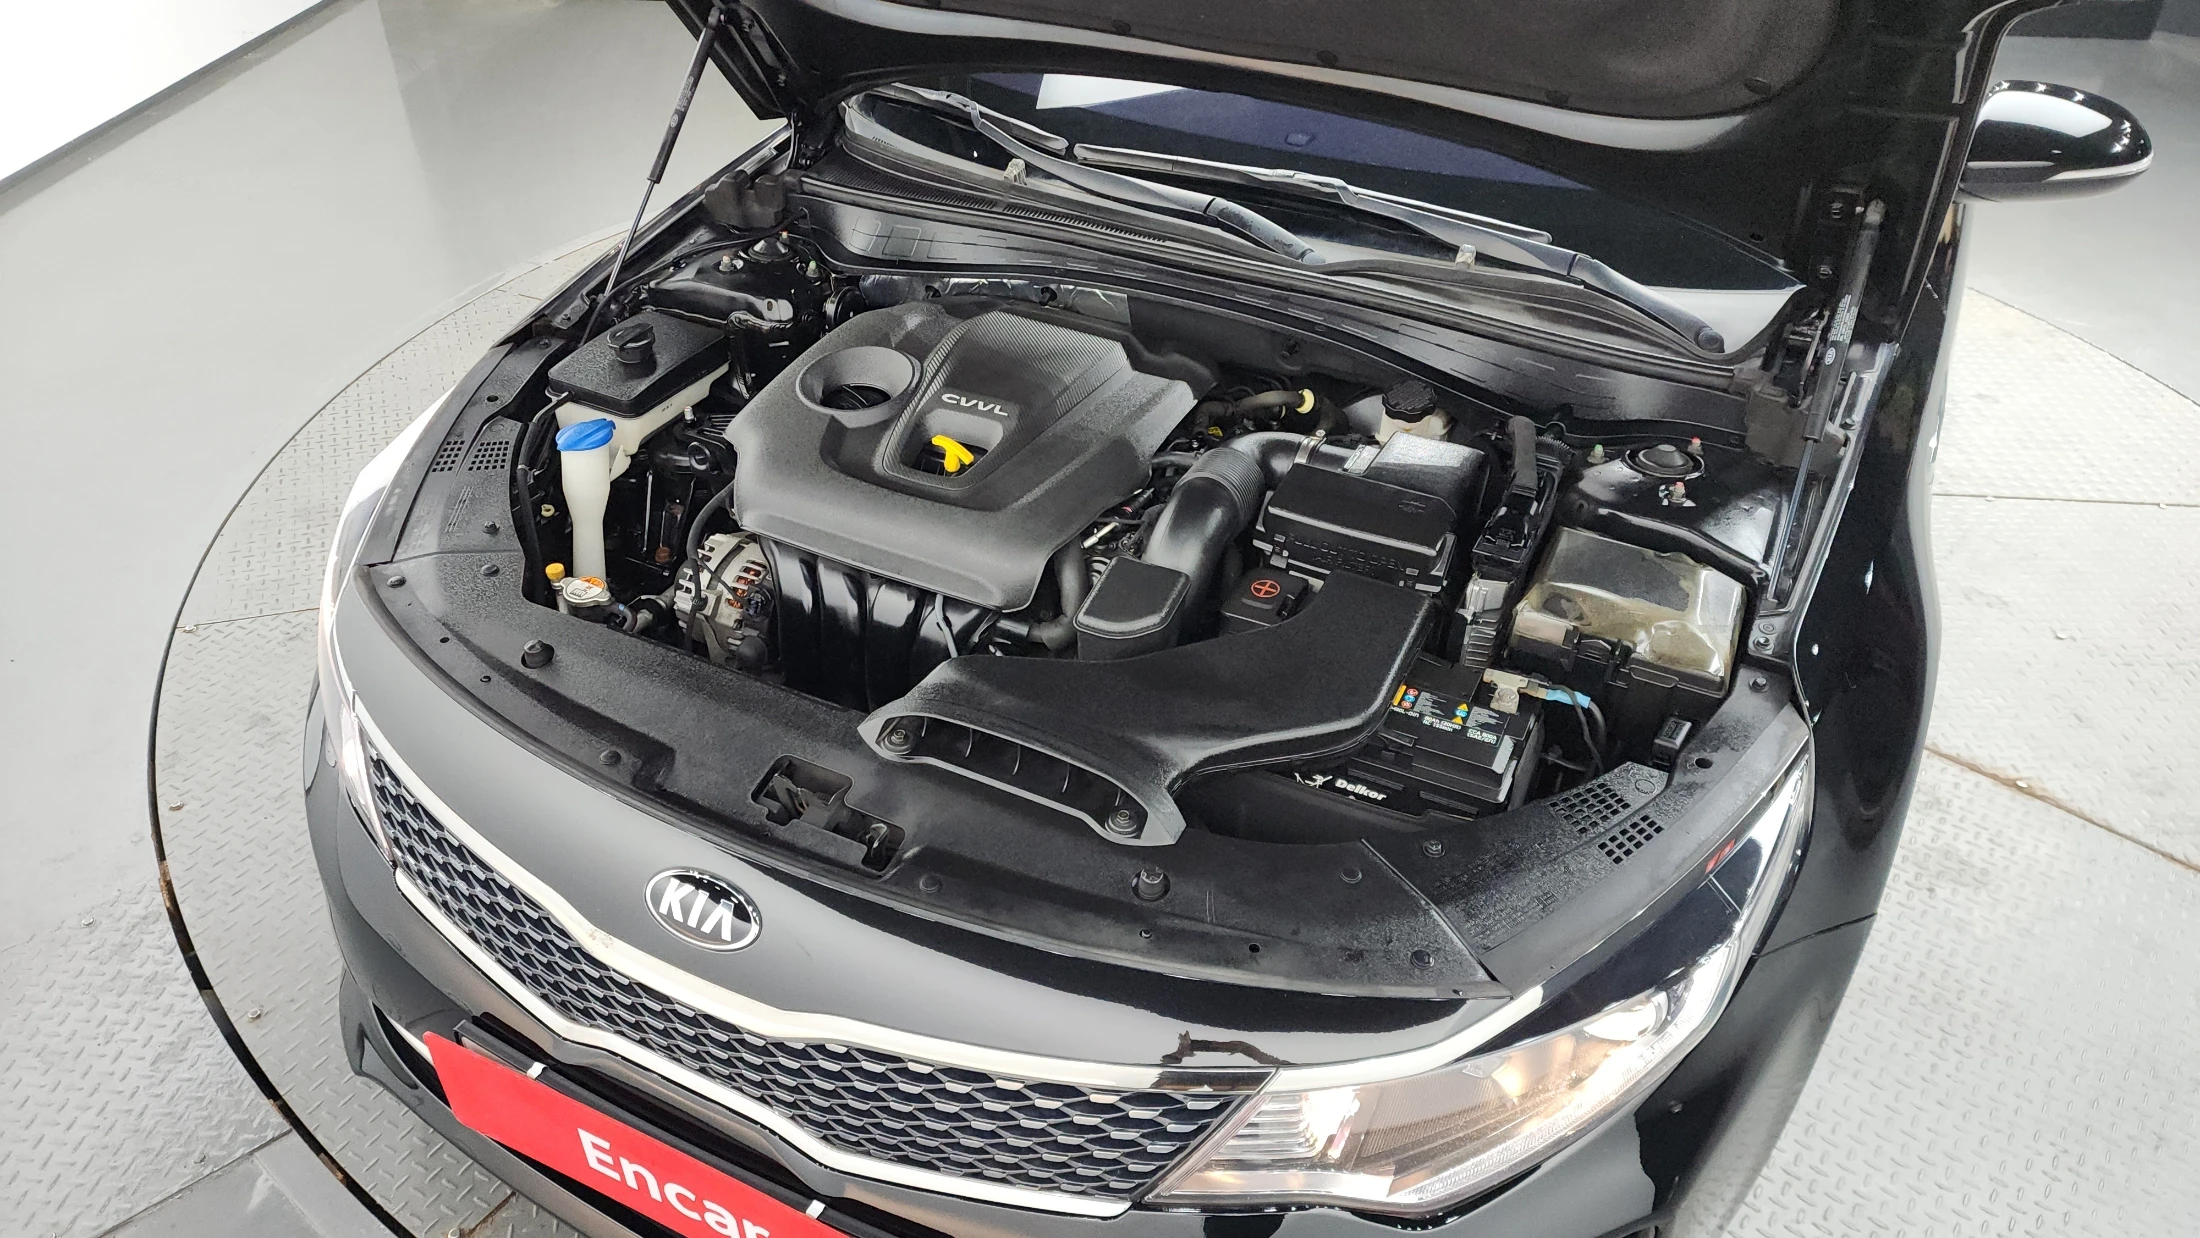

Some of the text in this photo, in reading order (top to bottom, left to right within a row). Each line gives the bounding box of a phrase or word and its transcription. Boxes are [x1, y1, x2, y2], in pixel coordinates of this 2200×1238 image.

[941, 393, 1009, 417] CVVL
[1335, 778, 1387, 801] Delkor
[658, 877, 735, 942] KIA
[577, 1127, 770, 1238] Encar
